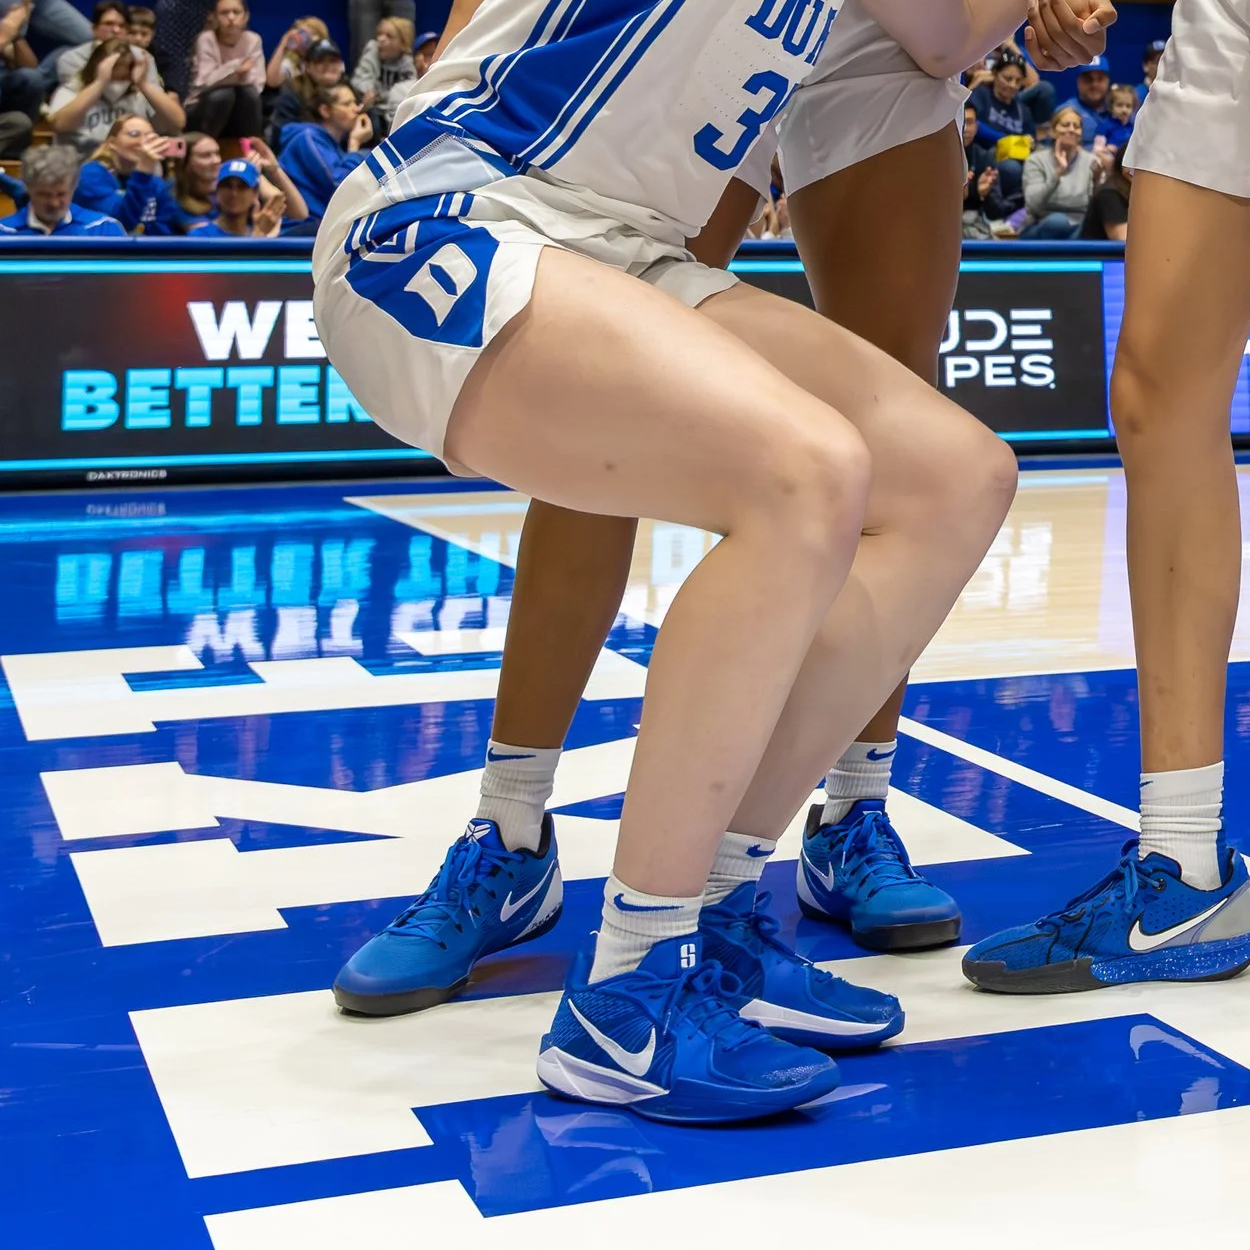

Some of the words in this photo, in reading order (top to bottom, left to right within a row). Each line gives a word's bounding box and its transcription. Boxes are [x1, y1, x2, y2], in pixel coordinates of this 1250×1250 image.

[693, 70, 800, 171] 3
[404, 243, 478, 327] D
[187, 301, 328, 360] WE
